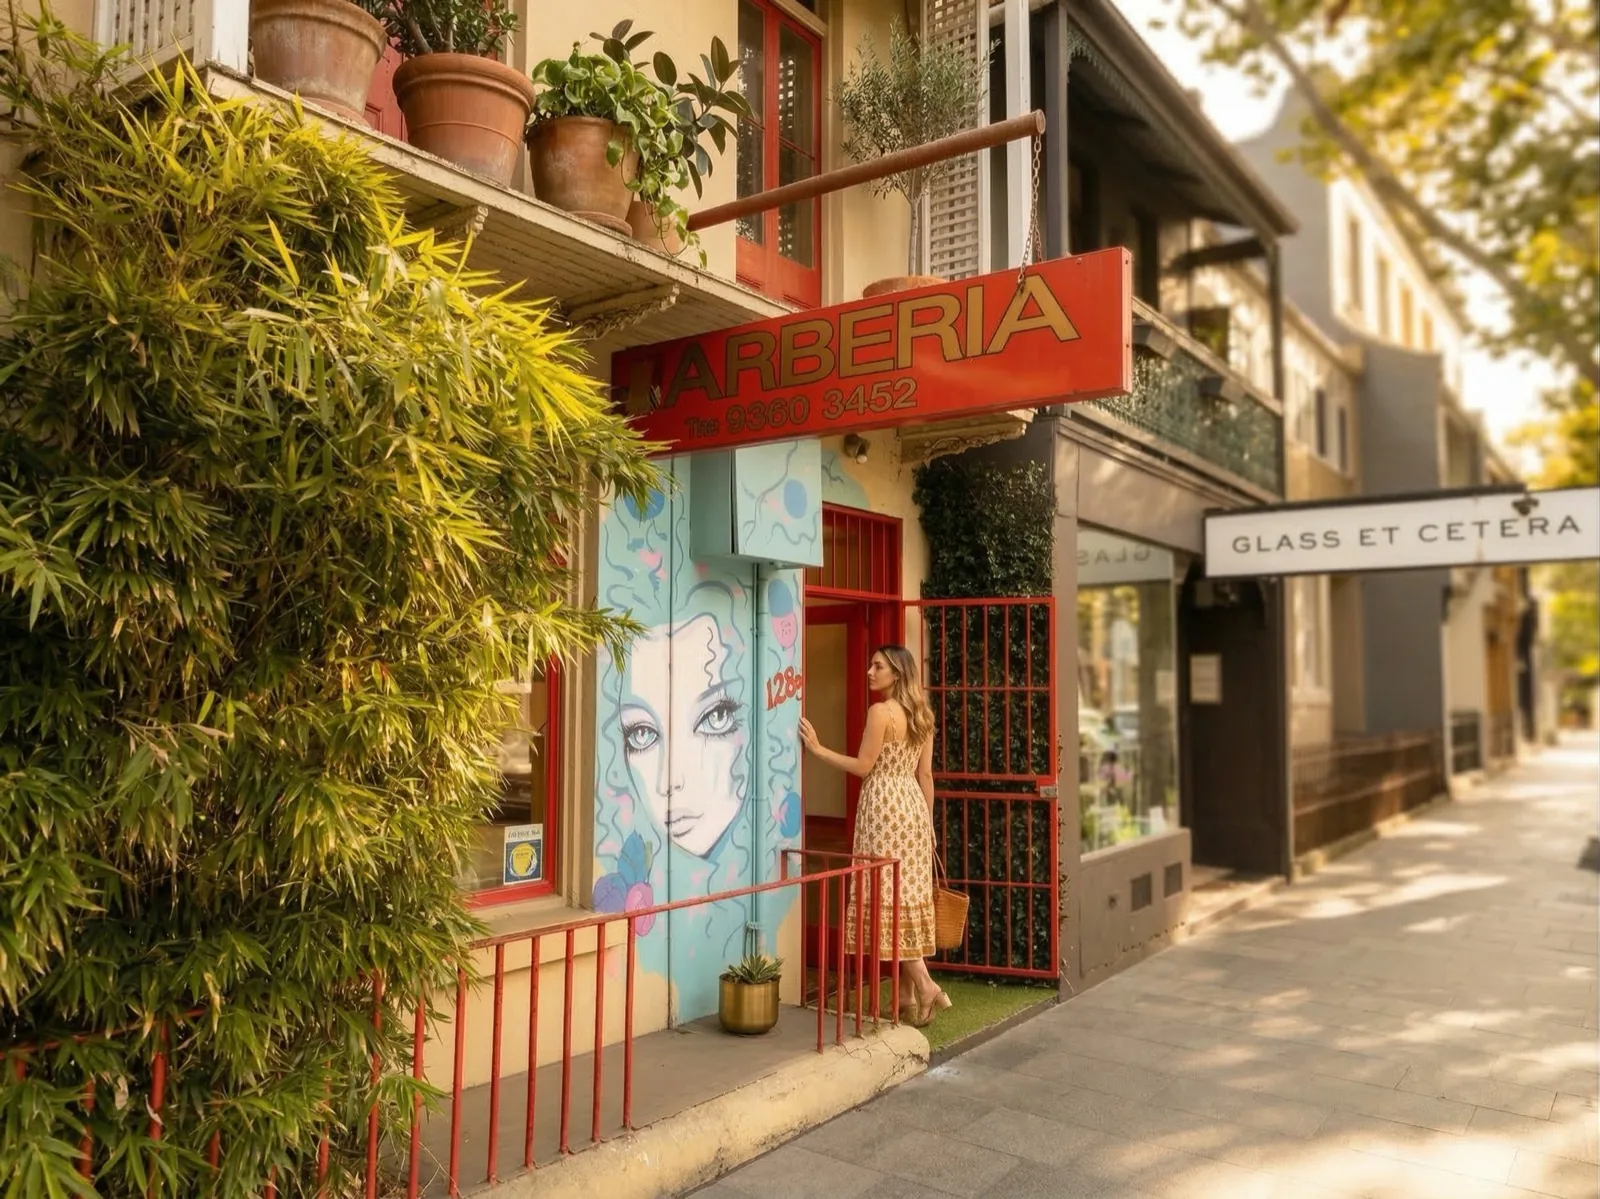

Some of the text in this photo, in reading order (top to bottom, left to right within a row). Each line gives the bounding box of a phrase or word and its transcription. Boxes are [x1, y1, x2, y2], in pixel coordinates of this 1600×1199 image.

[624, 272, 1082, 416] ARBERIA
[725, 394, 811, 434] 9360
[822, 376, 919, 421] 3452
[1232, 514, 1583, 555] GLASS ET CETERA
